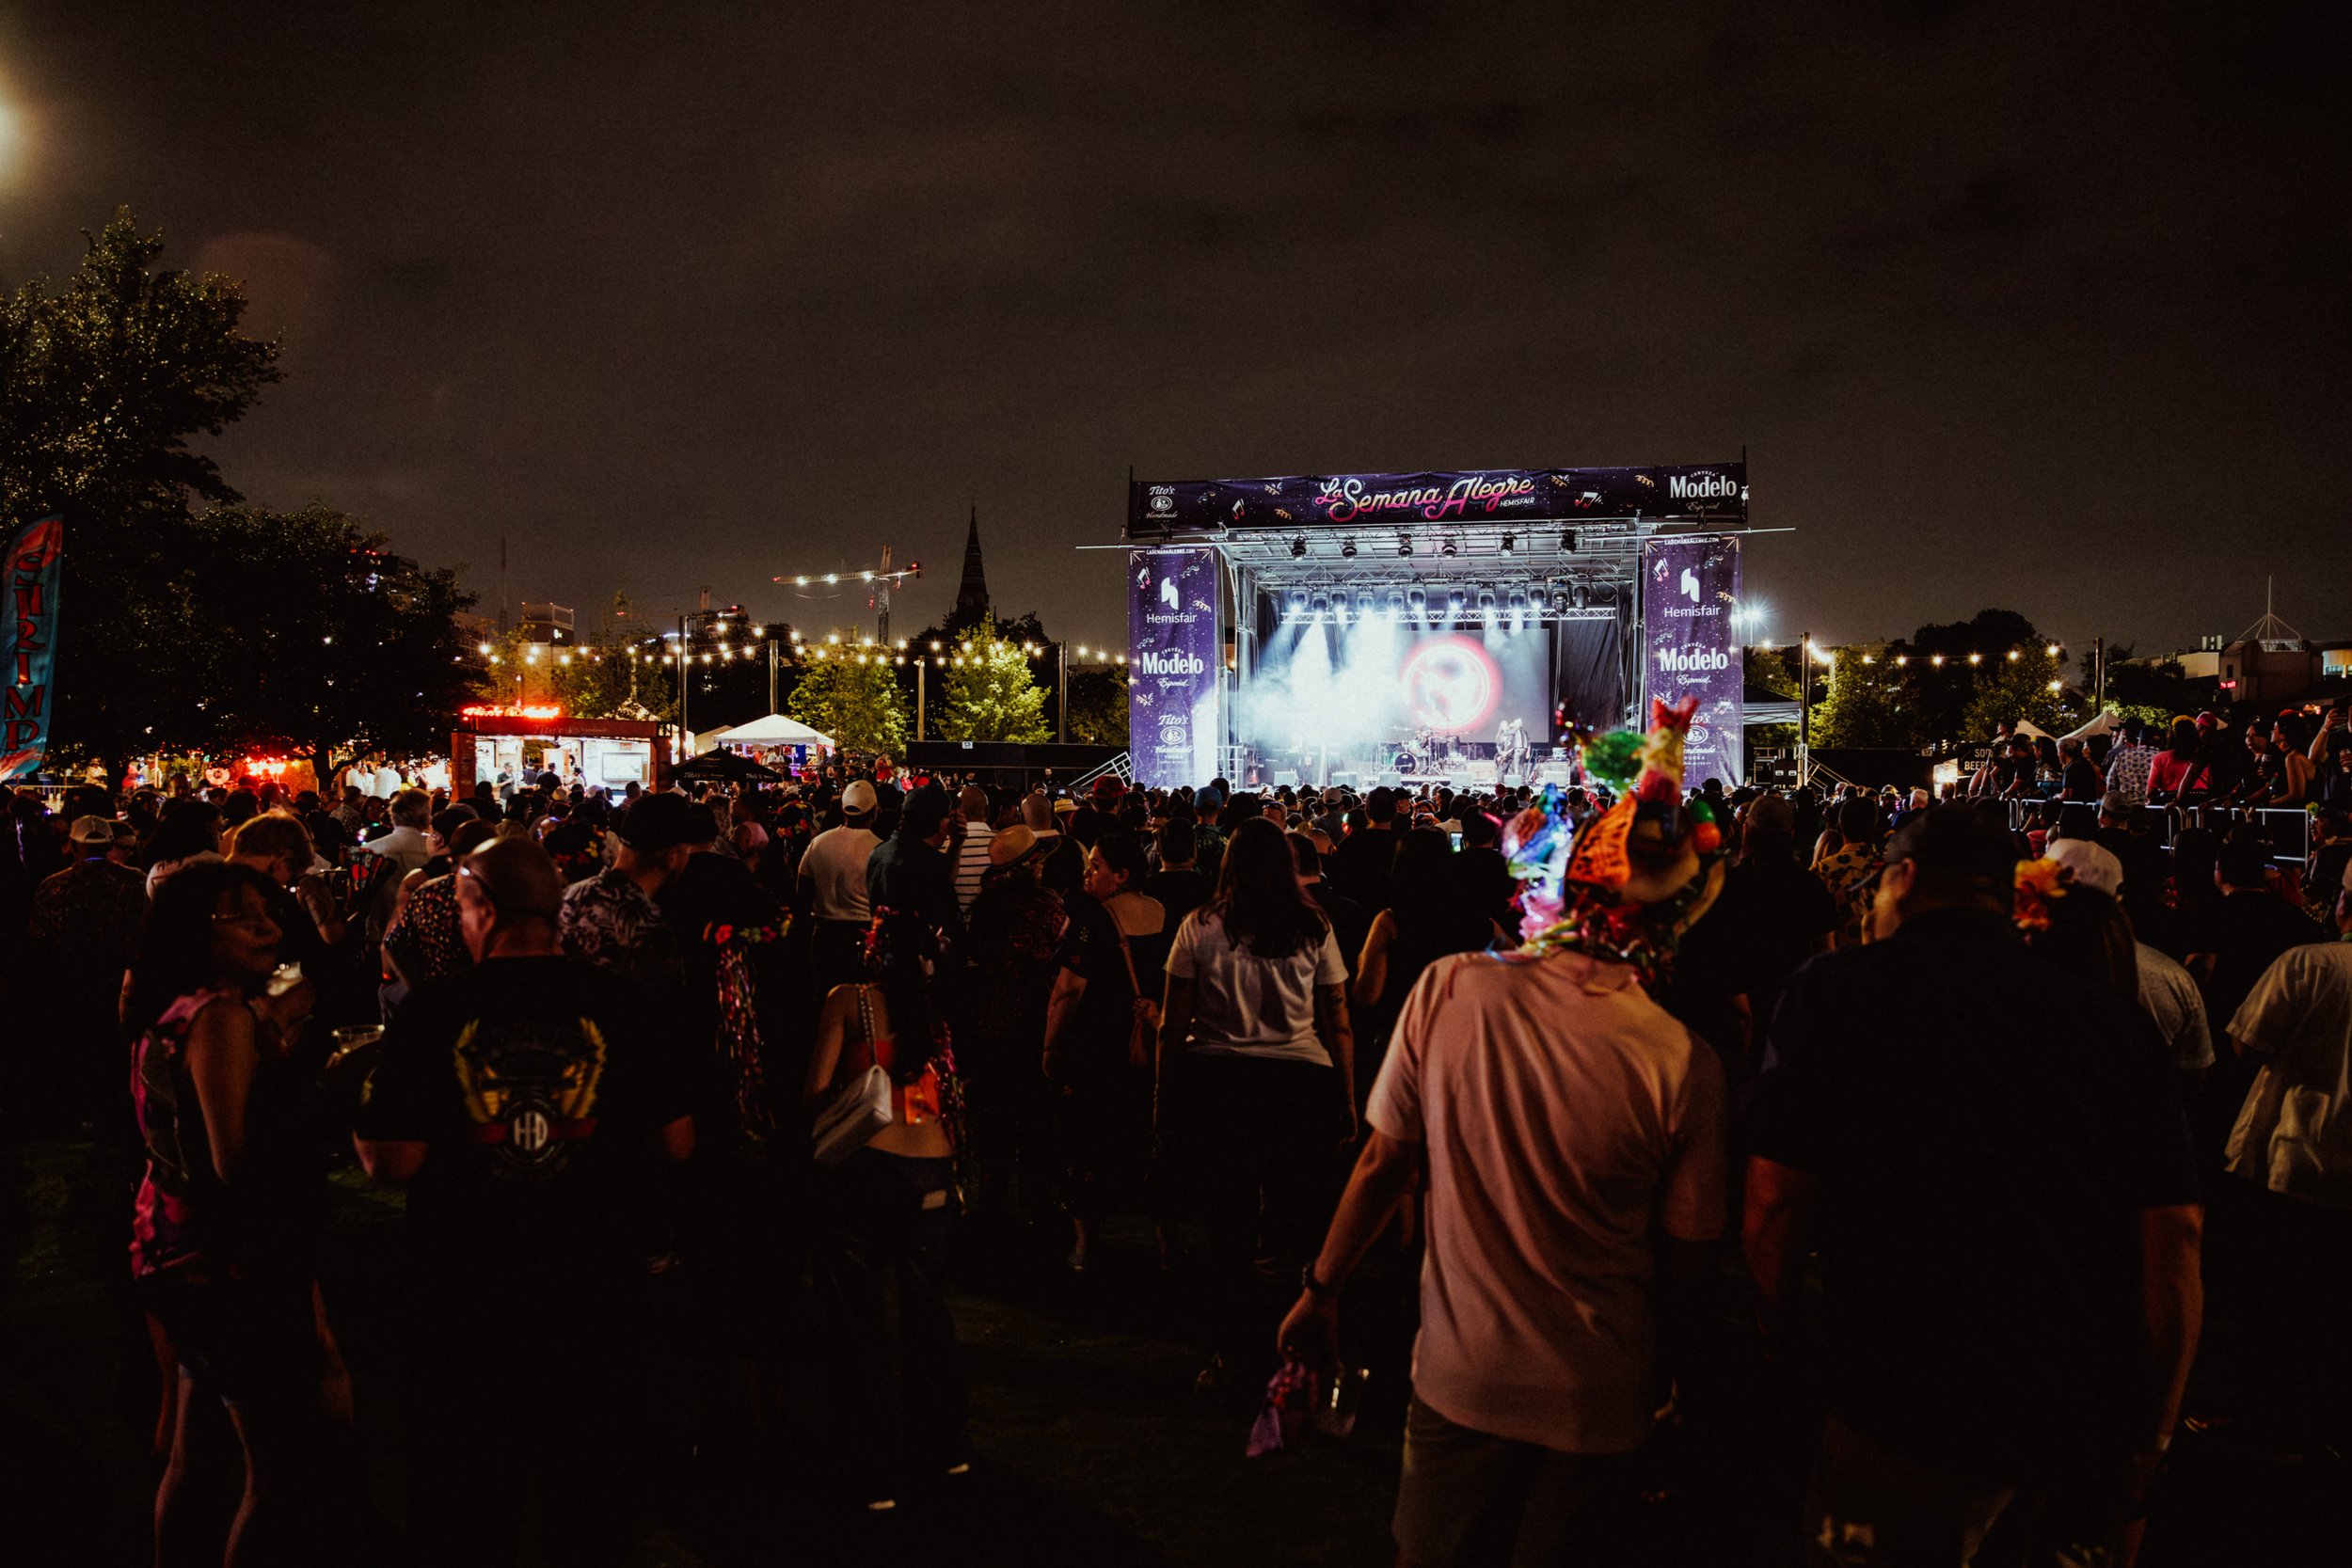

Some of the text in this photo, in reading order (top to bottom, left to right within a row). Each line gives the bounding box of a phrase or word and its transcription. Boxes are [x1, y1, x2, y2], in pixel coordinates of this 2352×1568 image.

[1149, 485, 1176, 496] Tito's
[1670, 475, 1737, 499] Modelo
[1315, 476, 1535, 523] La Semana Alegre
[1500, 497, 1535, 507] HEMISFAIR
[1663, 604, 1722, 617] Hemisfair
[1146, 612, 1198, 624] Hemisfair
[1142, 652, 1204, 674] Modelo
[1660, 647, 1728, 672] Modelo
[1158, 714, 1189, 725] Tito's
[1690, 713, 1711, 723] to's
